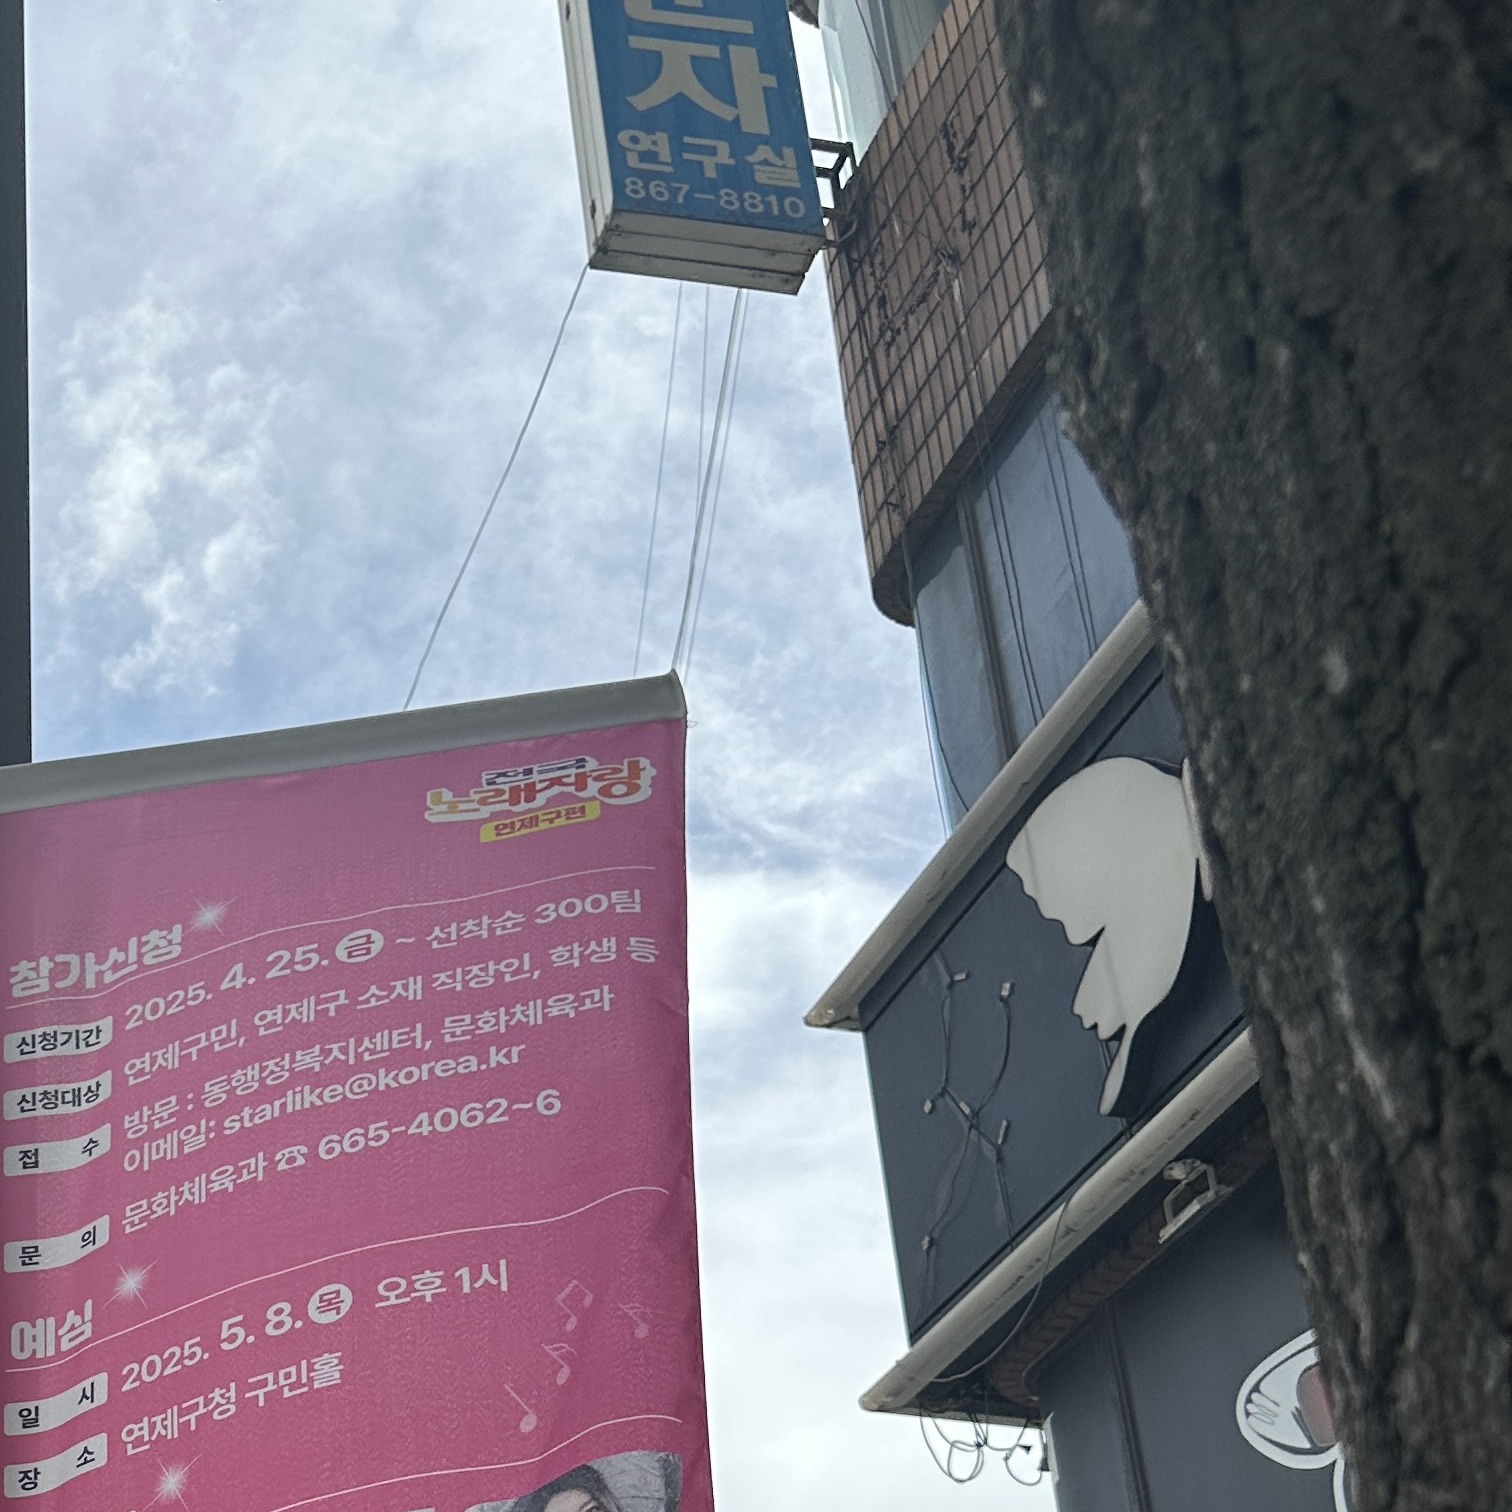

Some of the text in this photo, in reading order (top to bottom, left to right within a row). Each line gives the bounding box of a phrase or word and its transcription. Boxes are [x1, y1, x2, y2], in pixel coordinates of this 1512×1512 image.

[616, 127, 802, 189] 연구실
[623, 176, 806, 219] 867-8810
[427, 759, 647, 818] 노래자랑
[485, 756, 588, 787] 전국
[493, 804, 587, 837] 연제구편
[9, 923, 183, 998] 참가신청
[124, 980, 213, 1031] 2025.
[219, 961, 257, 991] 4.
[425, 910, 527, 950] 선착순
[533, 888, 643, 925] 300팀
[16, 1024, 103, 1057] 신청기간
[123, 935, 660, 1086] 연제구민, 연제구 소재 직장인, 학생 등
[200, 1022, 433, 1108] 동행정복지센터,
[440, 984, 615, 1043] 문화체육과
[16, 1079, 103, 1114] 신청대상
[122, 1043, 526, 1173] 이메일: starlike@korea.kr
[121, 1087, 563, 1235] 문화체육과 665-4062~6
[10, 1299, 94, 1361] 예심
[120, 1336, 210, 1393] 2025.
[219, 1313, 256, 1351] 5.
[374, 1268, 448, 1309] 오후
[453, 1257, 509, 1295] 1시
[120, 1351, 345, 1456] 연제구청 구민홀
